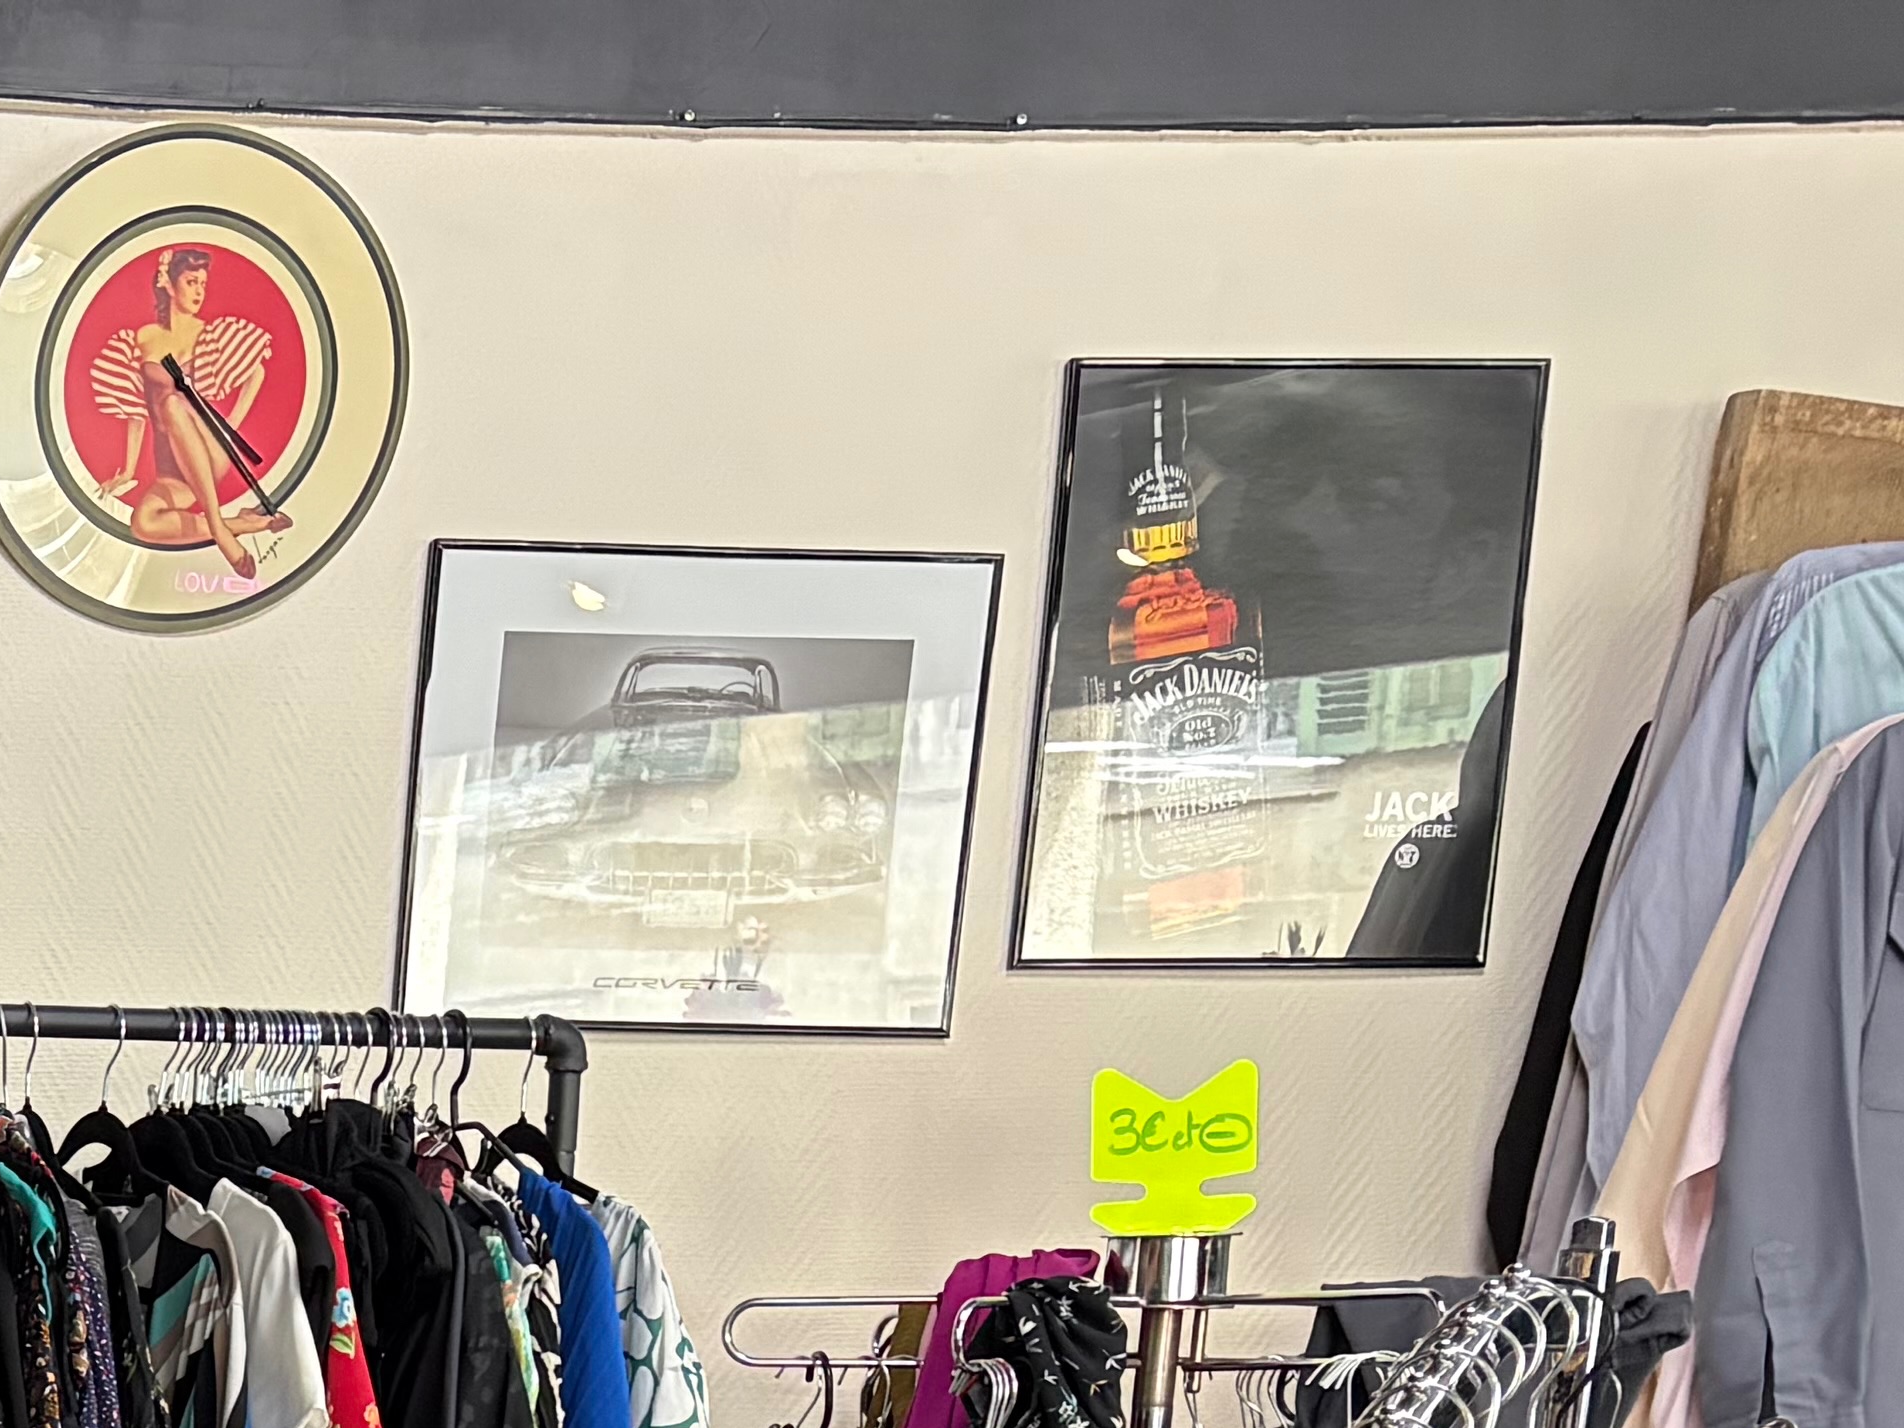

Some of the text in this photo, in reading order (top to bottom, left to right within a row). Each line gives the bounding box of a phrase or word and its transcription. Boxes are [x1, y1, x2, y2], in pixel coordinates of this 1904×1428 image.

[1131, 674, 1184, 724] JACK
[1184, 716, 1212, 732] Old
[1152, 786, 1252, 825] WHISKEY
[1364, 790, 1455, 822] JACK
[592, 976, 761, 991] CORVETTE
